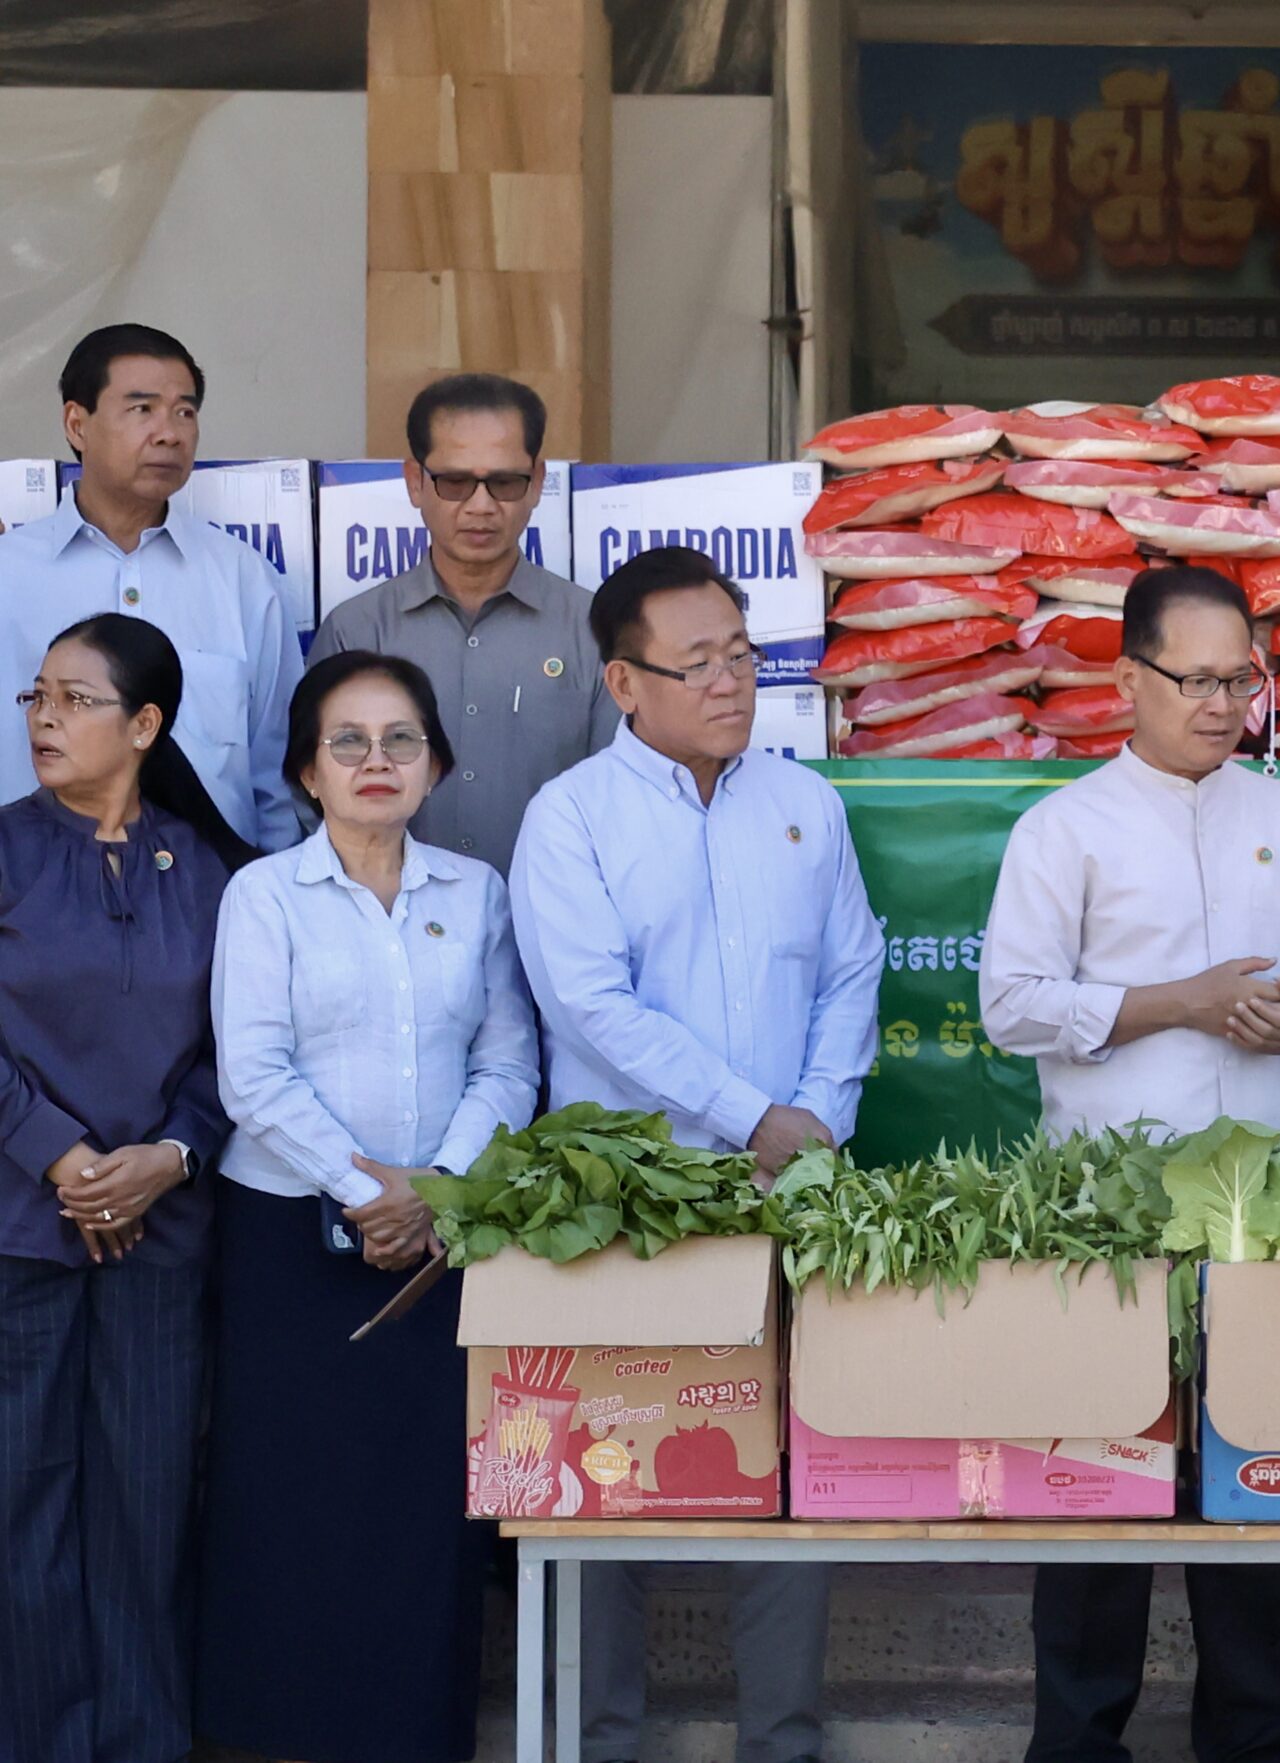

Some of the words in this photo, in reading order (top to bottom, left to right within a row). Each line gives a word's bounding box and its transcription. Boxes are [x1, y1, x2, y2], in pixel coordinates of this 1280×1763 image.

[678, 1382, 735, 1407] 사랑의
[740, 1380, 760, 1403] 맛
[1107, 1443, 1149, 1462] SNACK
[482, 1458, 553, 1508] Richy
[812, 1482, 837, 1494] A11
